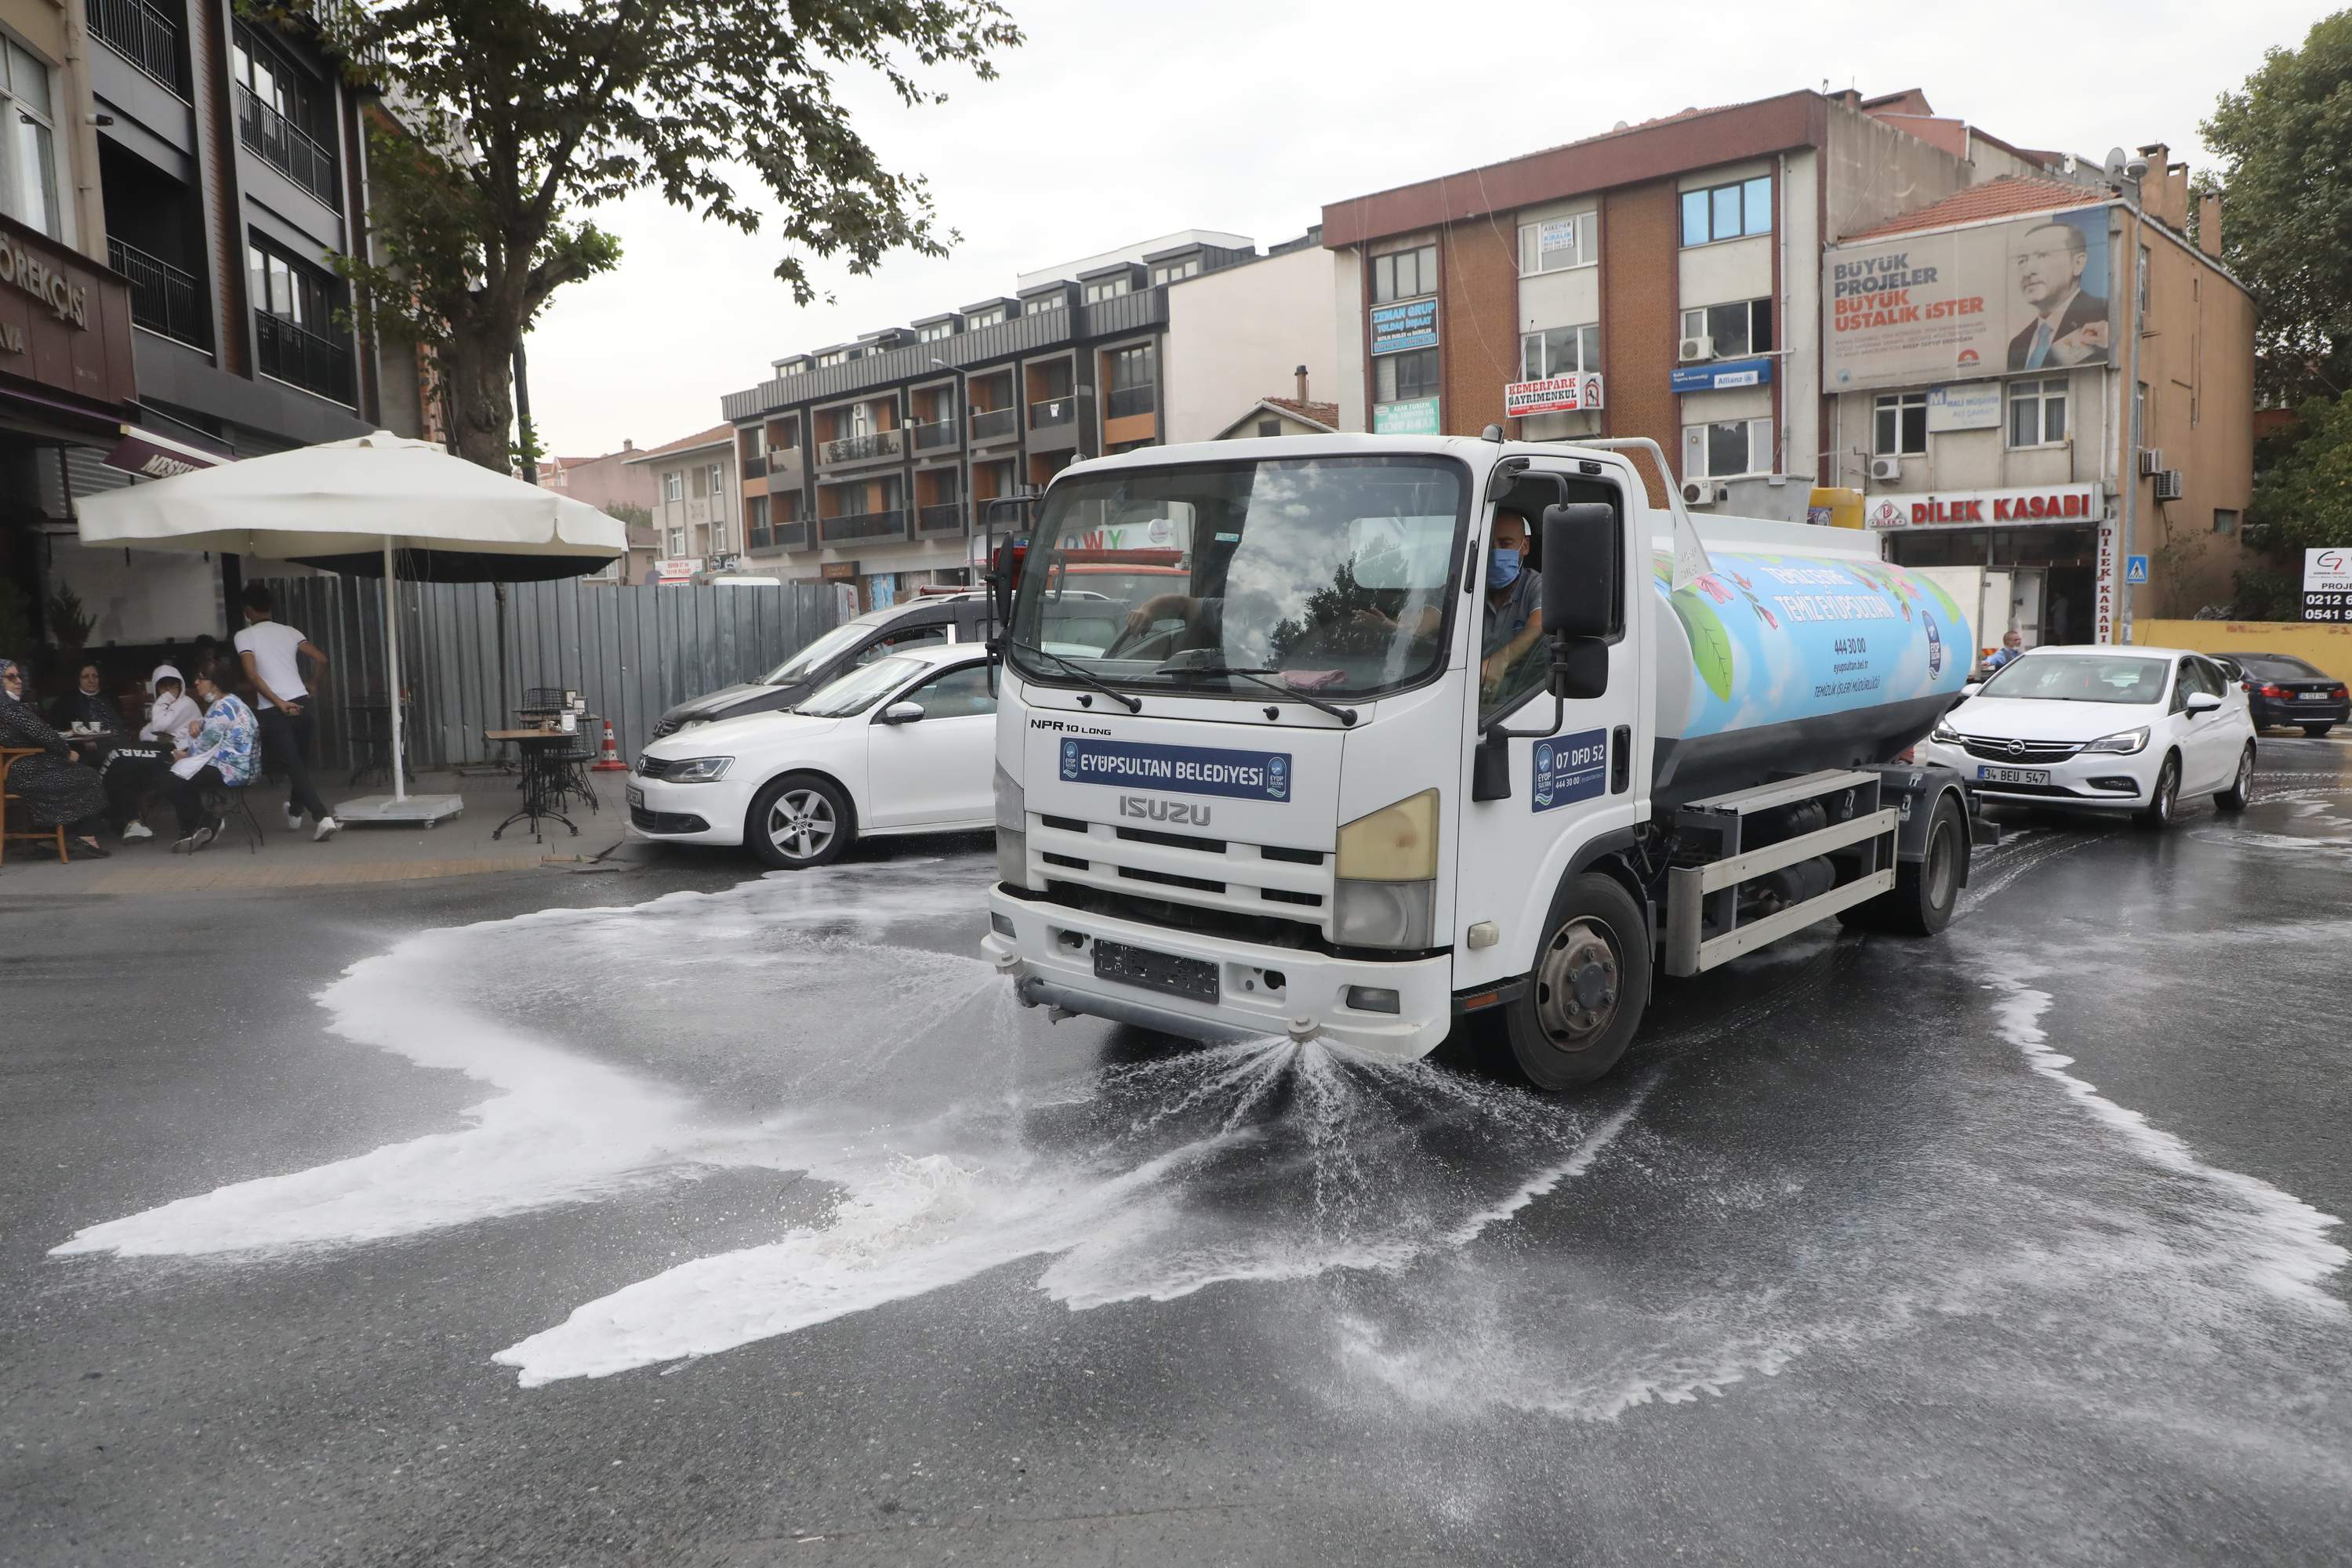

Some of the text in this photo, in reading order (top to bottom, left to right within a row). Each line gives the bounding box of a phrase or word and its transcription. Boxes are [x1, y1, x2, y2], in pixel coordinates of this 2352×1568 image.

[1834, 252, 1909, 280] BÜYÜK
[1834, 267, 1938, 298] PROJELER
[1835, 289, 1910, 315] BÜYÜK
[1373, 301, 1436, 324] ZEMAN GRUP
[1835, 296, 1984, 332] USTALIK İSTER
[1718, 376, 1744, 385] Allianz
[1911, 494, 2089, 524] DİLEK KASABI
[1772, 590, 1895, 622] TEMİZ EYÜPSULTAN
[2306, 594, 2342, 605] 0212
[2100, 585, 2111, 643] KASABI
[2305, 609, 2339, 620] 0541
[1835, 637, 1866, 655] 444 30 00
[1834, 659, 1868, 674] eyupsultan.bel.tr
[1814, 682, 1837, 698] TEMİZLİK
[1030, 719, 1064, 731] NPR
[1082, 727, 1112, 735] LONG
[118, 748, 162, 758] STAR
[1556, 744, 1604, 769] 07 DFD 52
[1080, 753, 1263, 786] EYÜPSULTAN BELEDİYESİ
[1537, 771, 1552, 782] EYÜP
[1984, 768, 2045, 783] 34 BEU 547
[1555, 779, 1566, 789] 444
[1566, 778, 1573, 787] 30
[1573, 776, 1580, 785] 00
[1120, 795, 1211, 826] ISUZU
